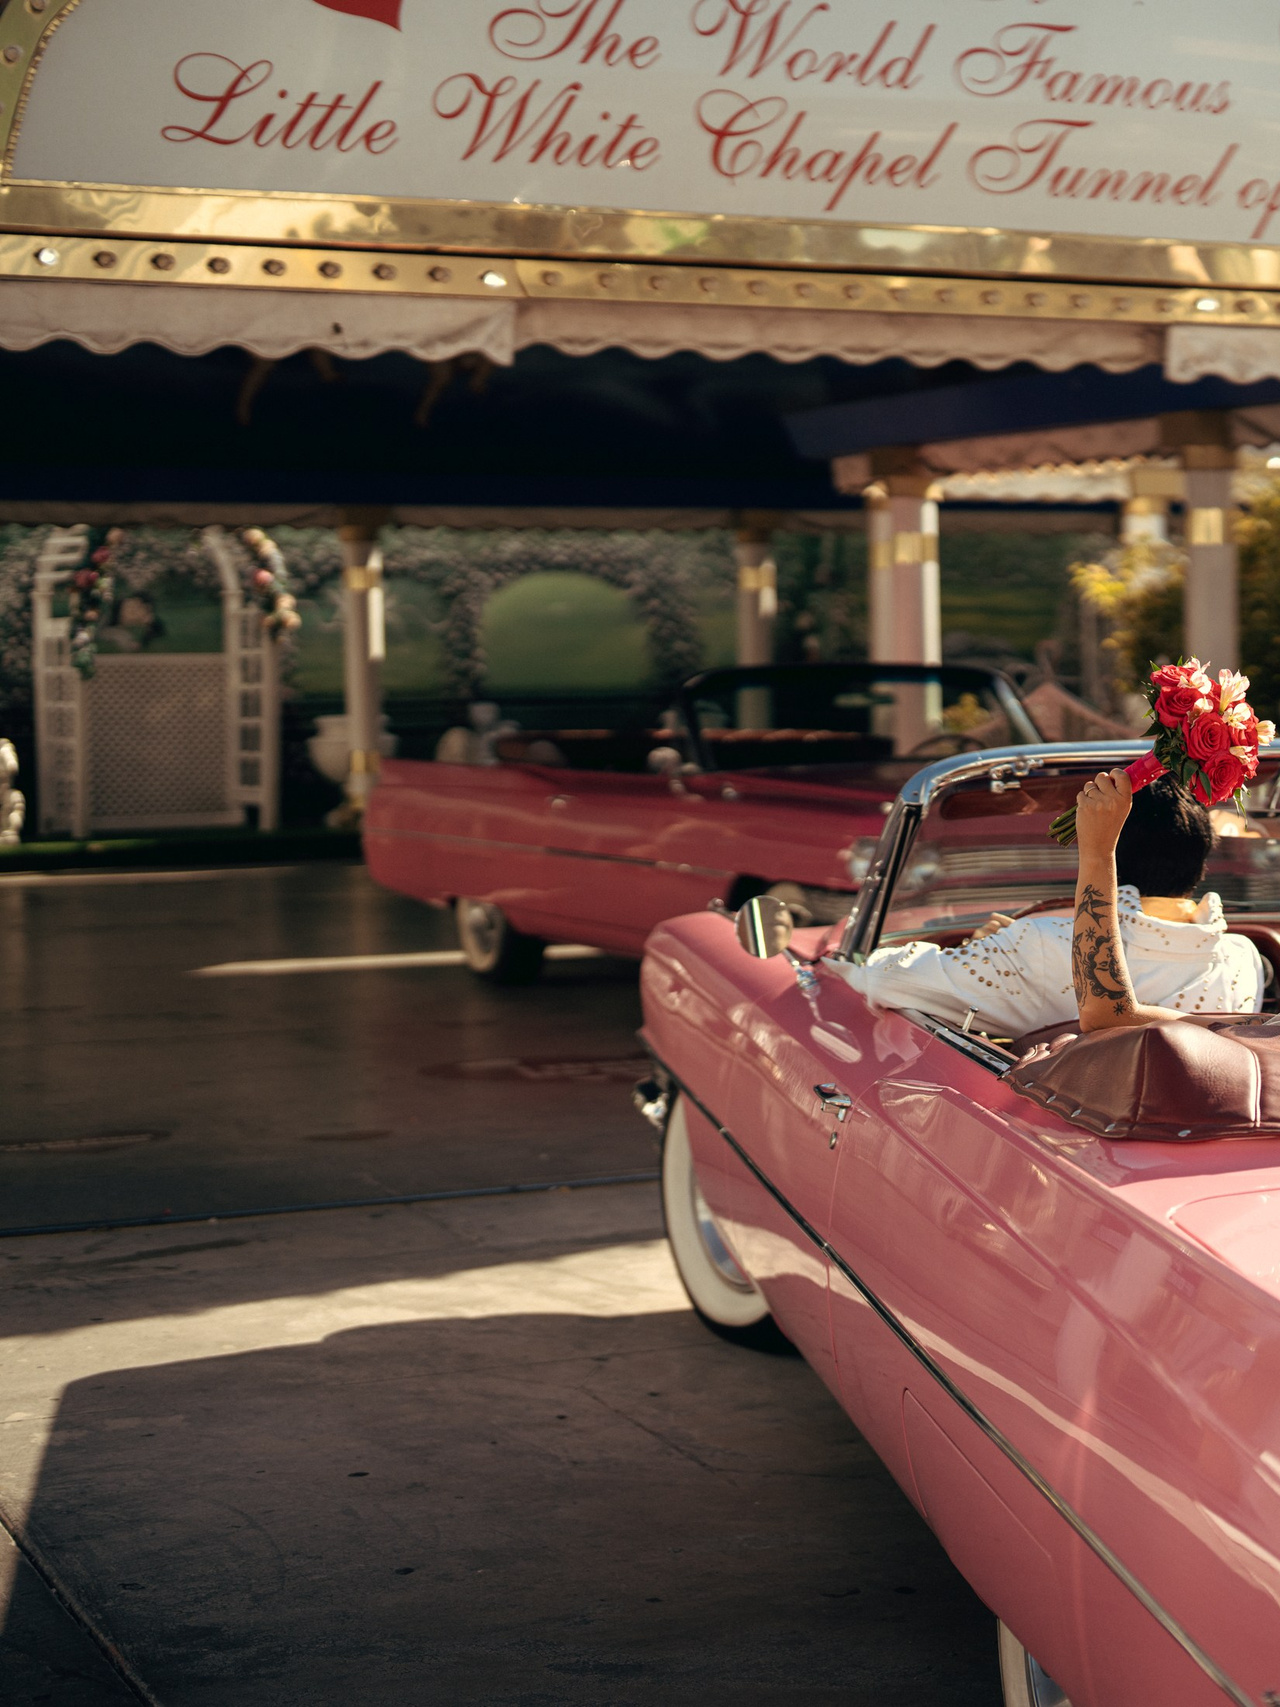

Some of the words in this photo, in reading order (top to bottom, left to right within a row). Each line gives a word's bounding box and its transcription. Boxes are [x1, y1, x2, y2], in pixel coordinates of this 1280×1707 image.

[489, 0, 661, 70] The
[692, 0, 936, 91] World
[953, 22, 1231, 115] Famous
[161, 52, 399, 155] Little
[432, 72, 662, 172] White
[696, 89, 960, 212] Chapel
[966, 118, 1240, 208] Tunnel
